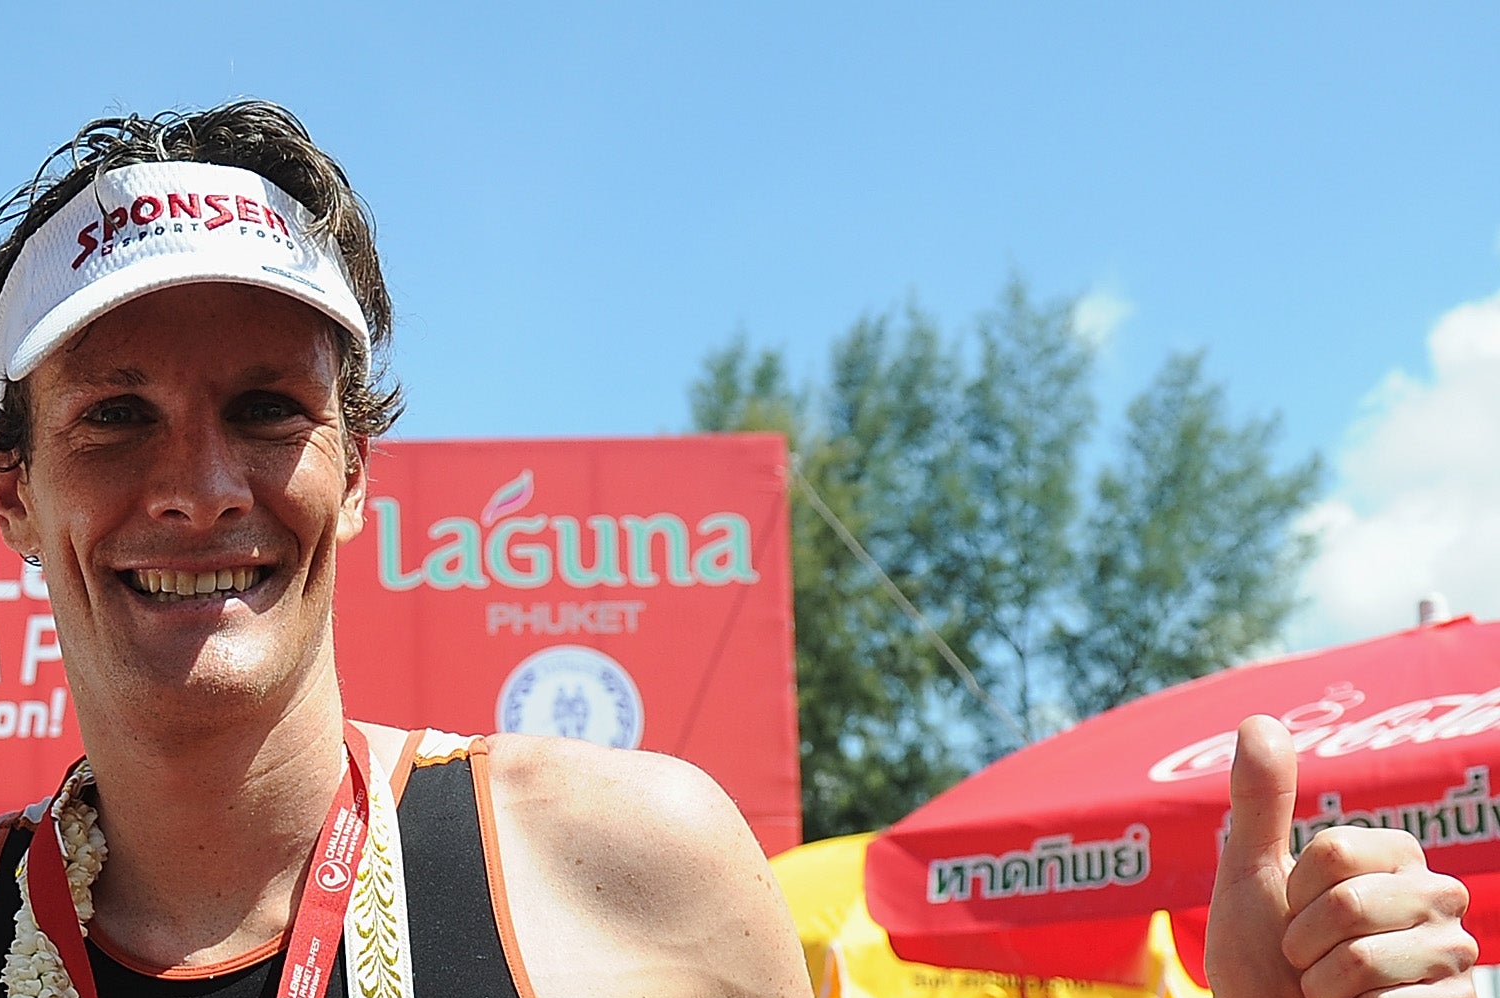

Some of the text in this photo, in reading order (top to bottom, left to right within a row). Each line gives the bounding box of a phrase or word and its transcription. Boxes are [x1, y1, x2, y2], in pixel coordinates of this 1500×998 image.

[71, 193, 290, 270] SPONSER
[239, 225, 295, 250] FOOD
[485, 600, 648, 636] PHUKET
